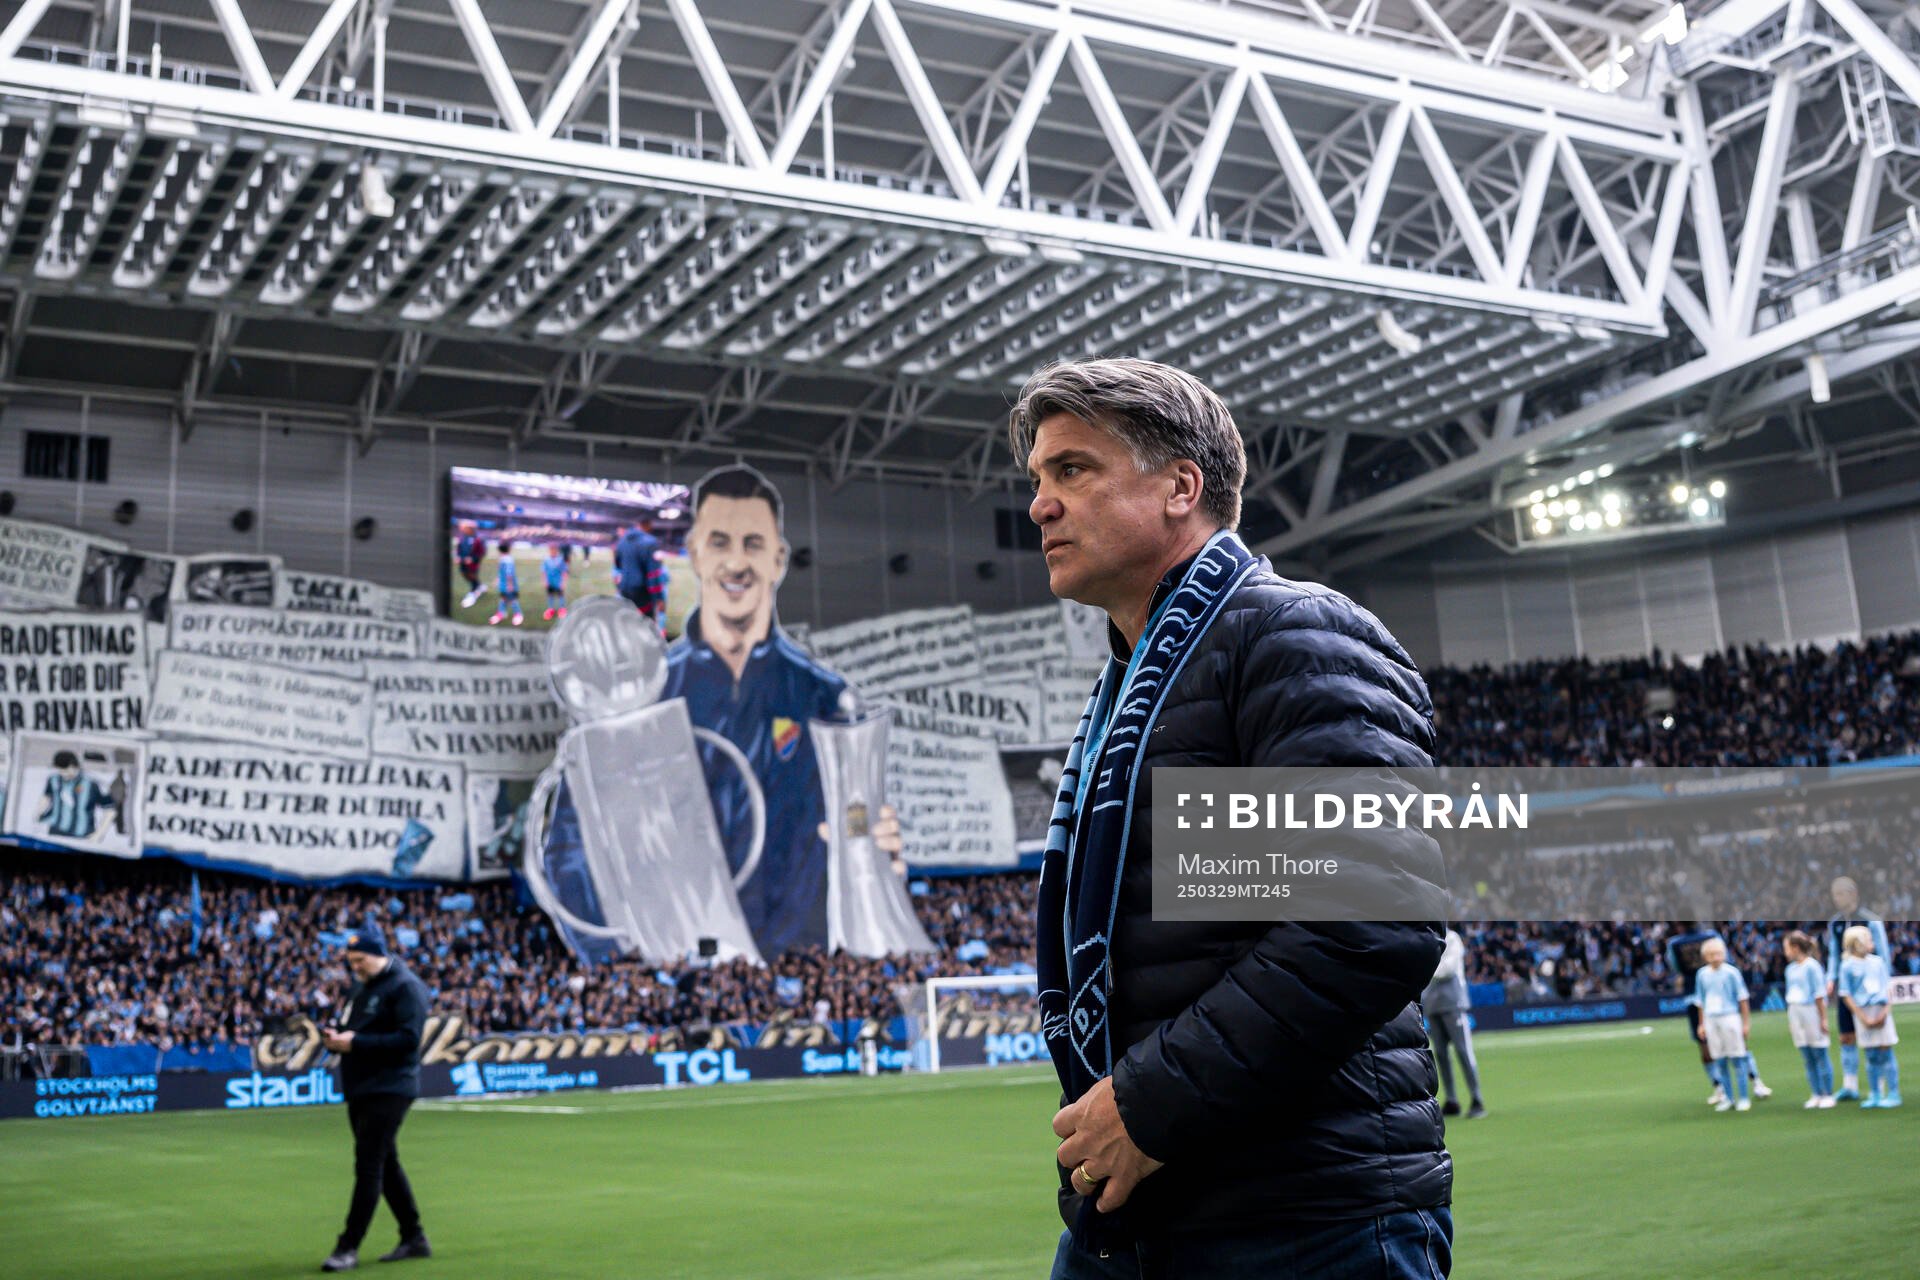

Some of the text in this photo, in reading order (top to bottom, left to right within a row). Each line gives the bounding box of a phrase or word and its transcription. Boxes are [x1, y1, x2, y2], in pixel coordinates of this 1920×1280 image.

[0, 624, 136, 656] RADETINAC
[34, 697, 143, 733] RIVALEN
[148, 754, 454, 793] RADETINAC TILLBAKA
[165, 783, 234, 809] SPEL
[653, 1048, 751, 1086] TCL
[35, 1074, 158, 1096] STOCKHOLMS
